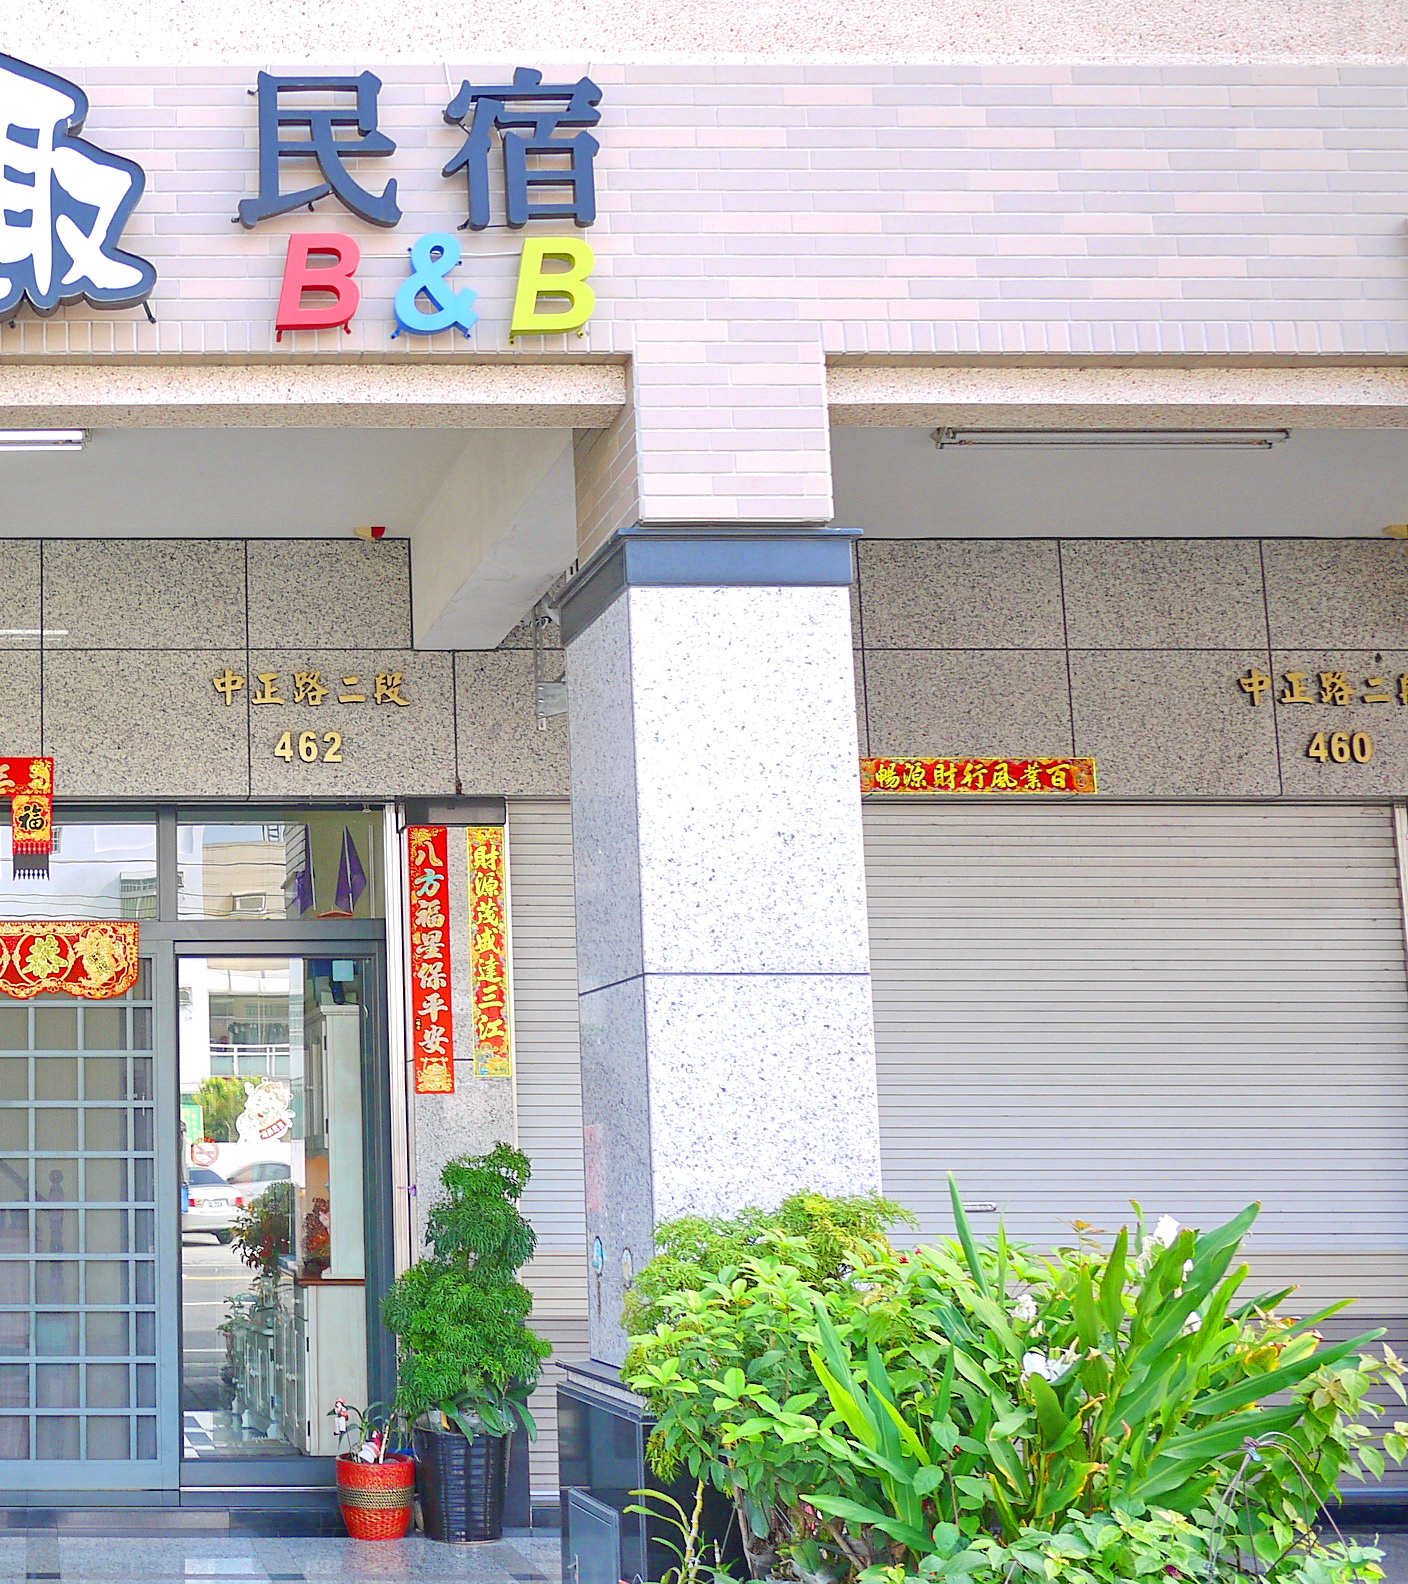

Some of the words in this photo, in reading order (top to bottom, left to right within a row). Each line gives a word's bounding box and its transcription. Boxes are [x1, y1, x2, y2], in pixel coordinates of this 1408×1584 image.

[235, 66, 603, 231] 民宿
[212, 668, 411, 707] 中正路二段
[1238, 668, 1408, 707] 中正路二
[274, 730, 344, 763] 462
[1308, 731, 1373, 764] 460
[18, 804, 47, 832] 福
[414, 840, 450, 1056] 八方福星保平安
[471, 844, 507, 1041] 財源茂盛達三江
